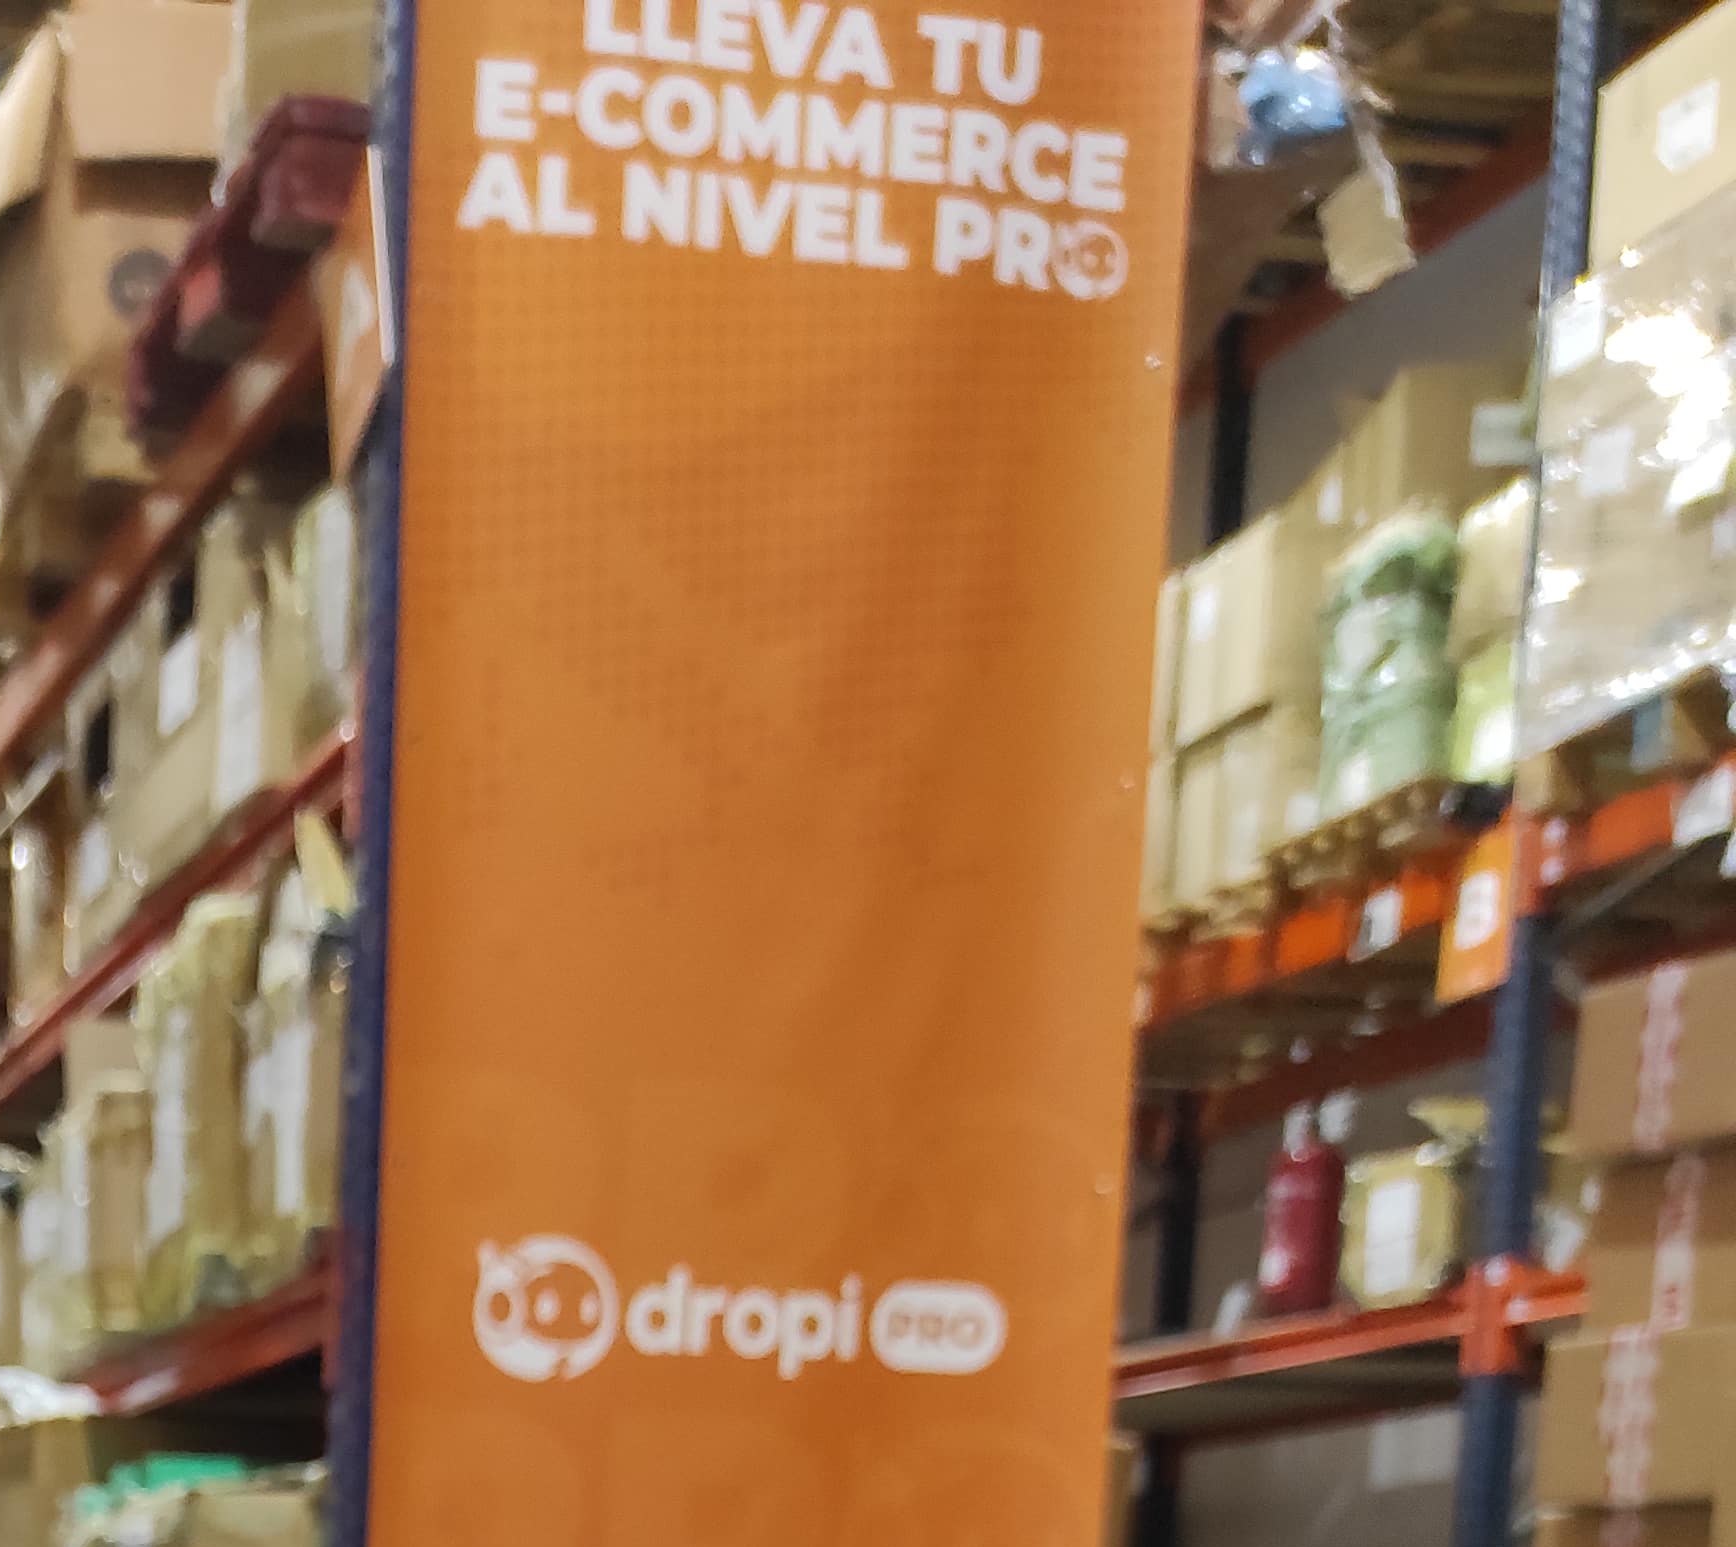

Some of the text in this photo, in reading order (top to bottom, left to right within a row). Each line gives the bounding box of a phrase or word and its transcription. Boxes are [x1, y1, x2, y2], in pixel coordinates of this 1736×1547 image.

[581, 0, 1043, 106] LLEVA TU
[473, 57, 1129, 213] E-COMMERCE
[457, 152, 598, 238] AL
[621, 158, 910, 270] NIVEL
[625, 1264, 862, 1380] dropi
